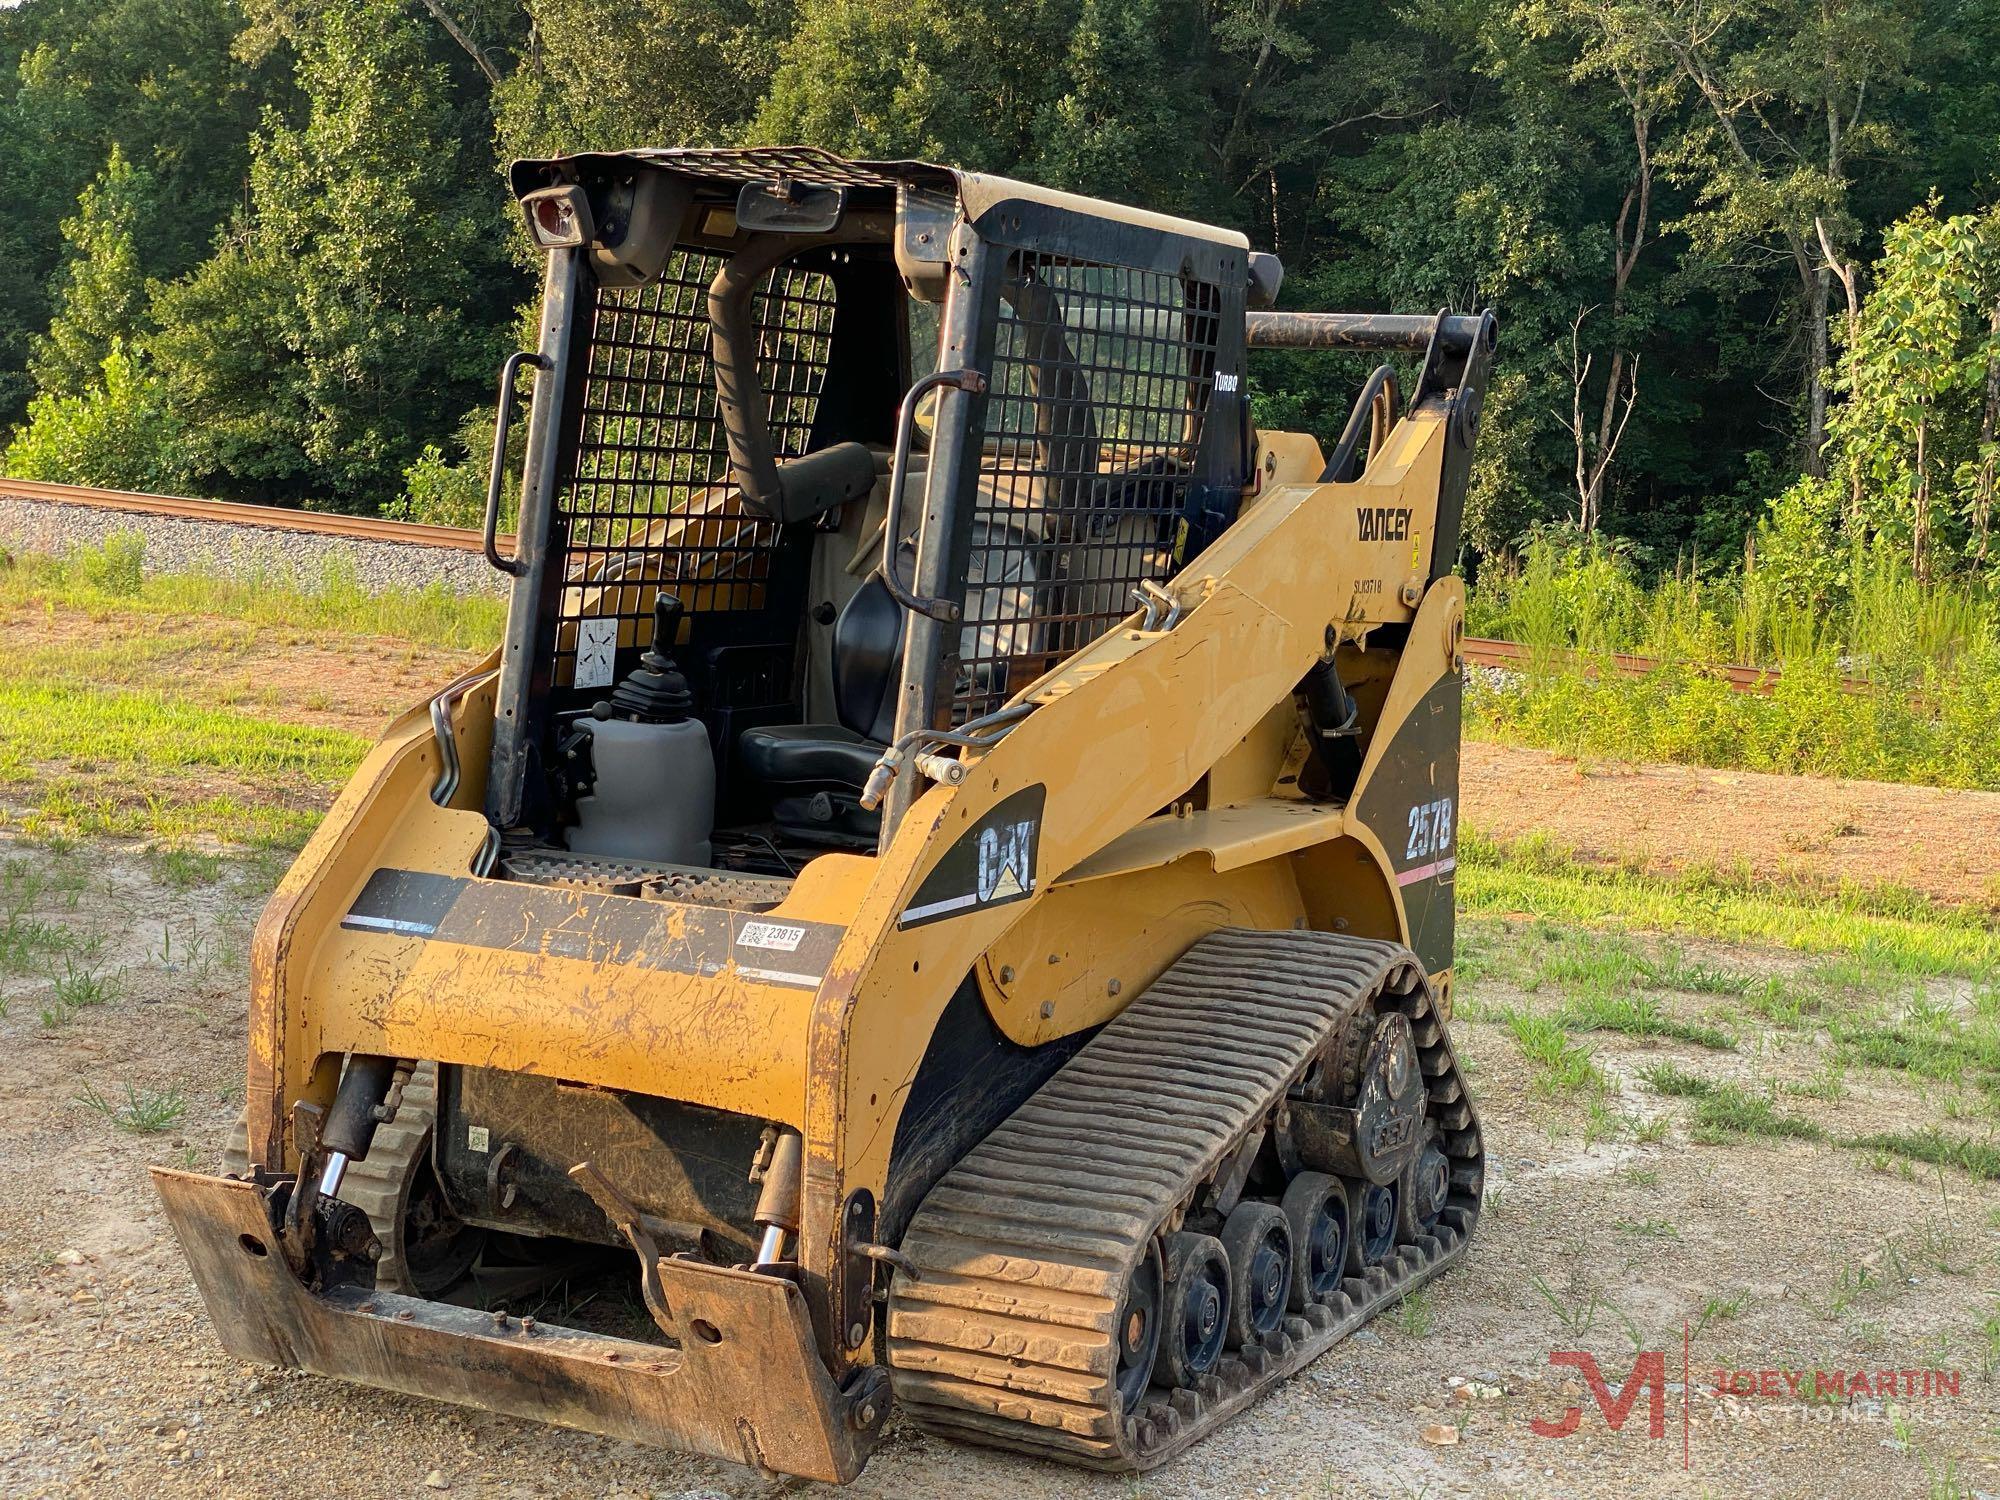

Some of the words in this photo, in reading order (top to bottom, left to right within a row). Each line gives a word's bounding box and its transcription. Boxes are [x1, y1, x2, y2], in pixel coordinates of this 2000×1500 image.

[1214, 370, 1238, 392] TURBO
[1357, 507, 1413, 541] YANCEY
[1406, 797, 1452, 860] 257B
[978, 821, 1035, 902] CAT
[767, 926, 801, 941] 23815
